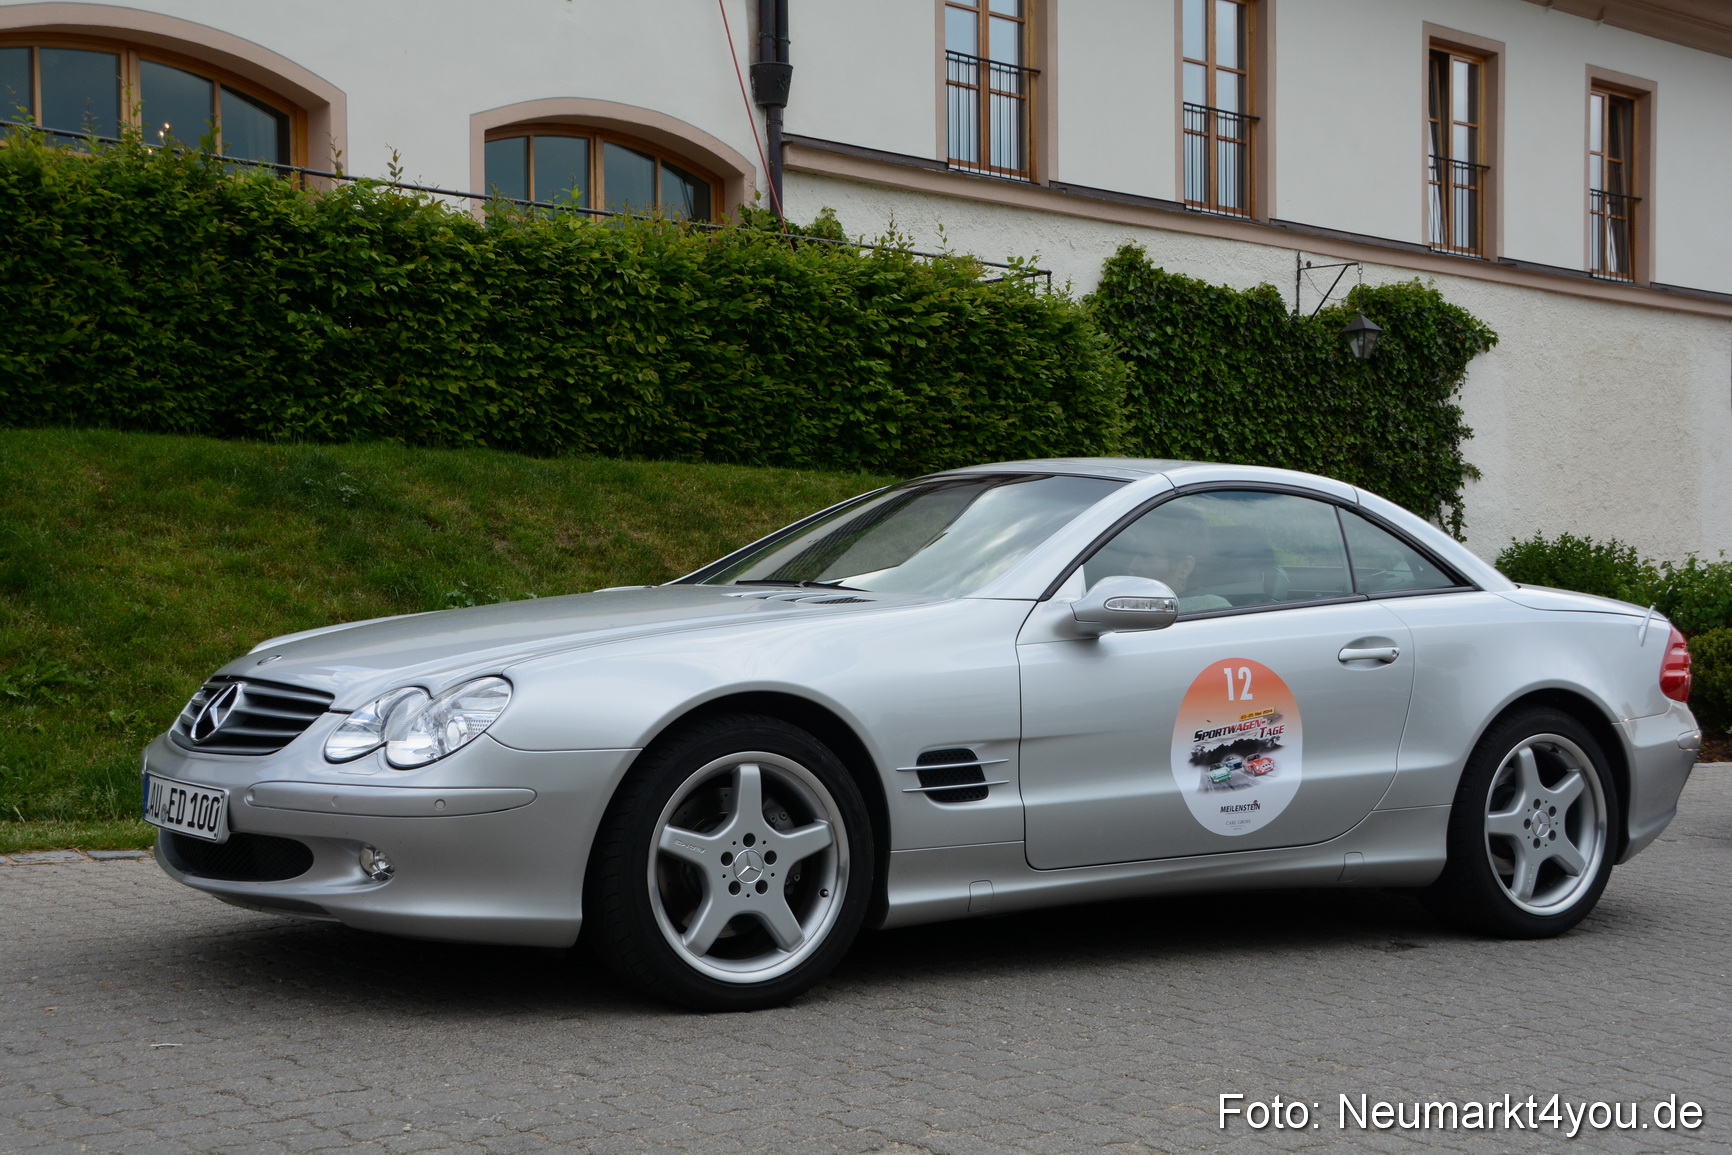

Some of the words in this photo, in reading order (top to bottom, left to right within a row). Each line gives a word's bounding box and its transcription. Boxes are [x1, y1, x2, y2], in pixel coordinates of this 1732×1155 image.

[1223, 666, 1253, 701] 12
[167, 787, 187, 825] ED
[187, 792, 220, 832] 100
